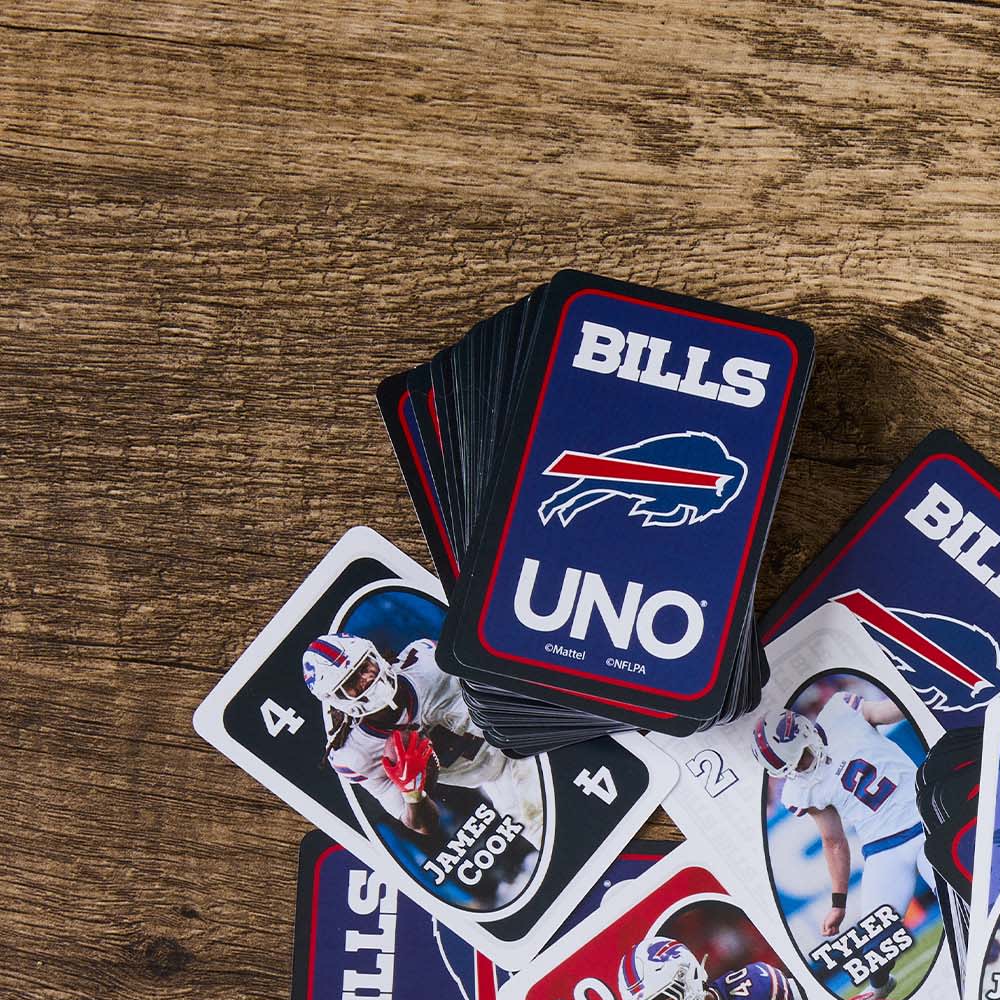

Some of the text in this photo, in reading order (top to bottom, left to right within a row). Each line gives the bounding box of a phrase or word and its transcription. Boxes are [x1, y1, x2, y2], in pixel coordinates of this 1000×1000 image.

[572, 321, 771, 408] BILLS
[514, 558, 707, 660] UNO
[545, 643, 646, 676] ©Mattel ©NFLPA
[259, 698, 305, 738] 4
[573, 766, 618, 805] 4
[685, 748, 739, 798] 2
[840, 757, 897, 813] 2
[423, 802, 497, 886] JAMES
[456, 815, 524, 886] COOK
[810, 903, 902, 972] TYLER
[843, 927, 914, 987] BASS
